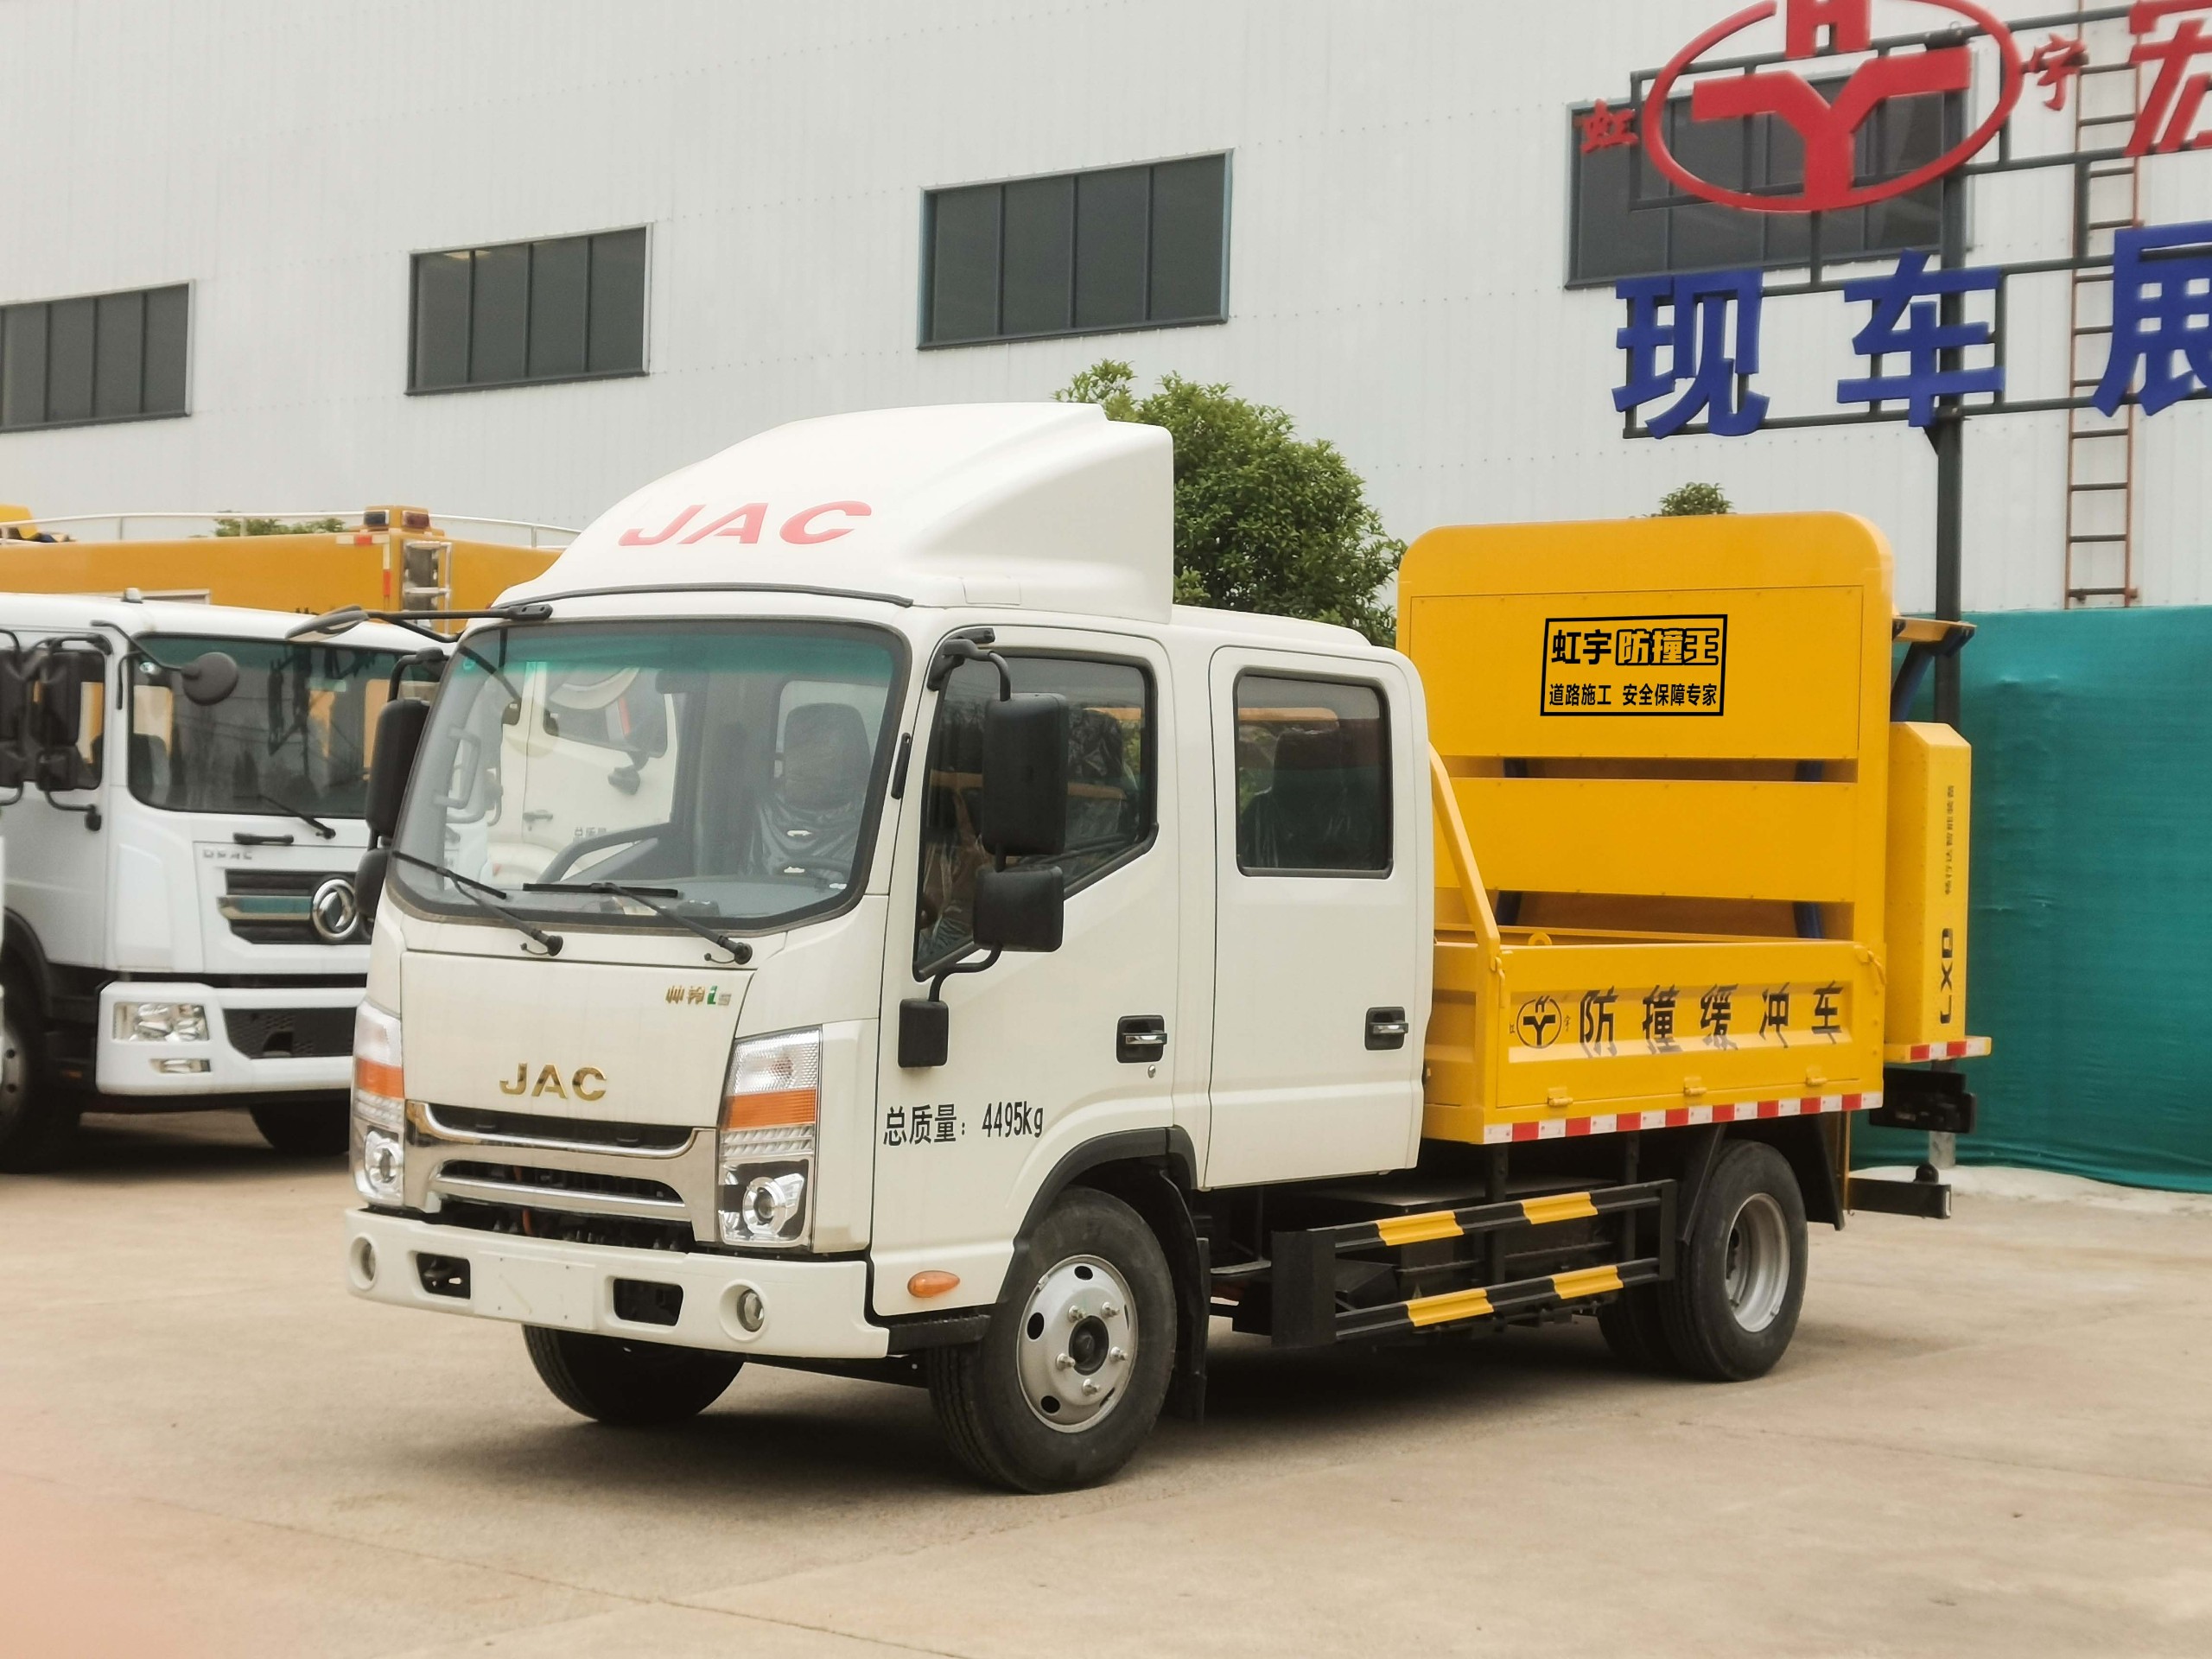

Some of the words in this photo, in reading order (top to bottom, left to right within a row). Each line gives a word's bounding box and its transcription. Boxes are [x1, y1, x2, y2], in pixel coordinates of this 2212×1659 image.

[618, 500, 872, 546] JAC
[1549, 683, 1611, 706] 道路施工
[1623, 683, 1718, 706] 安全保障专家
[1580, 981, 1843, 1059] 防撞缓冲车
[499, 1062, 607, 1102] JAC
[982, 1101, 1044, 1138] 4495kg
